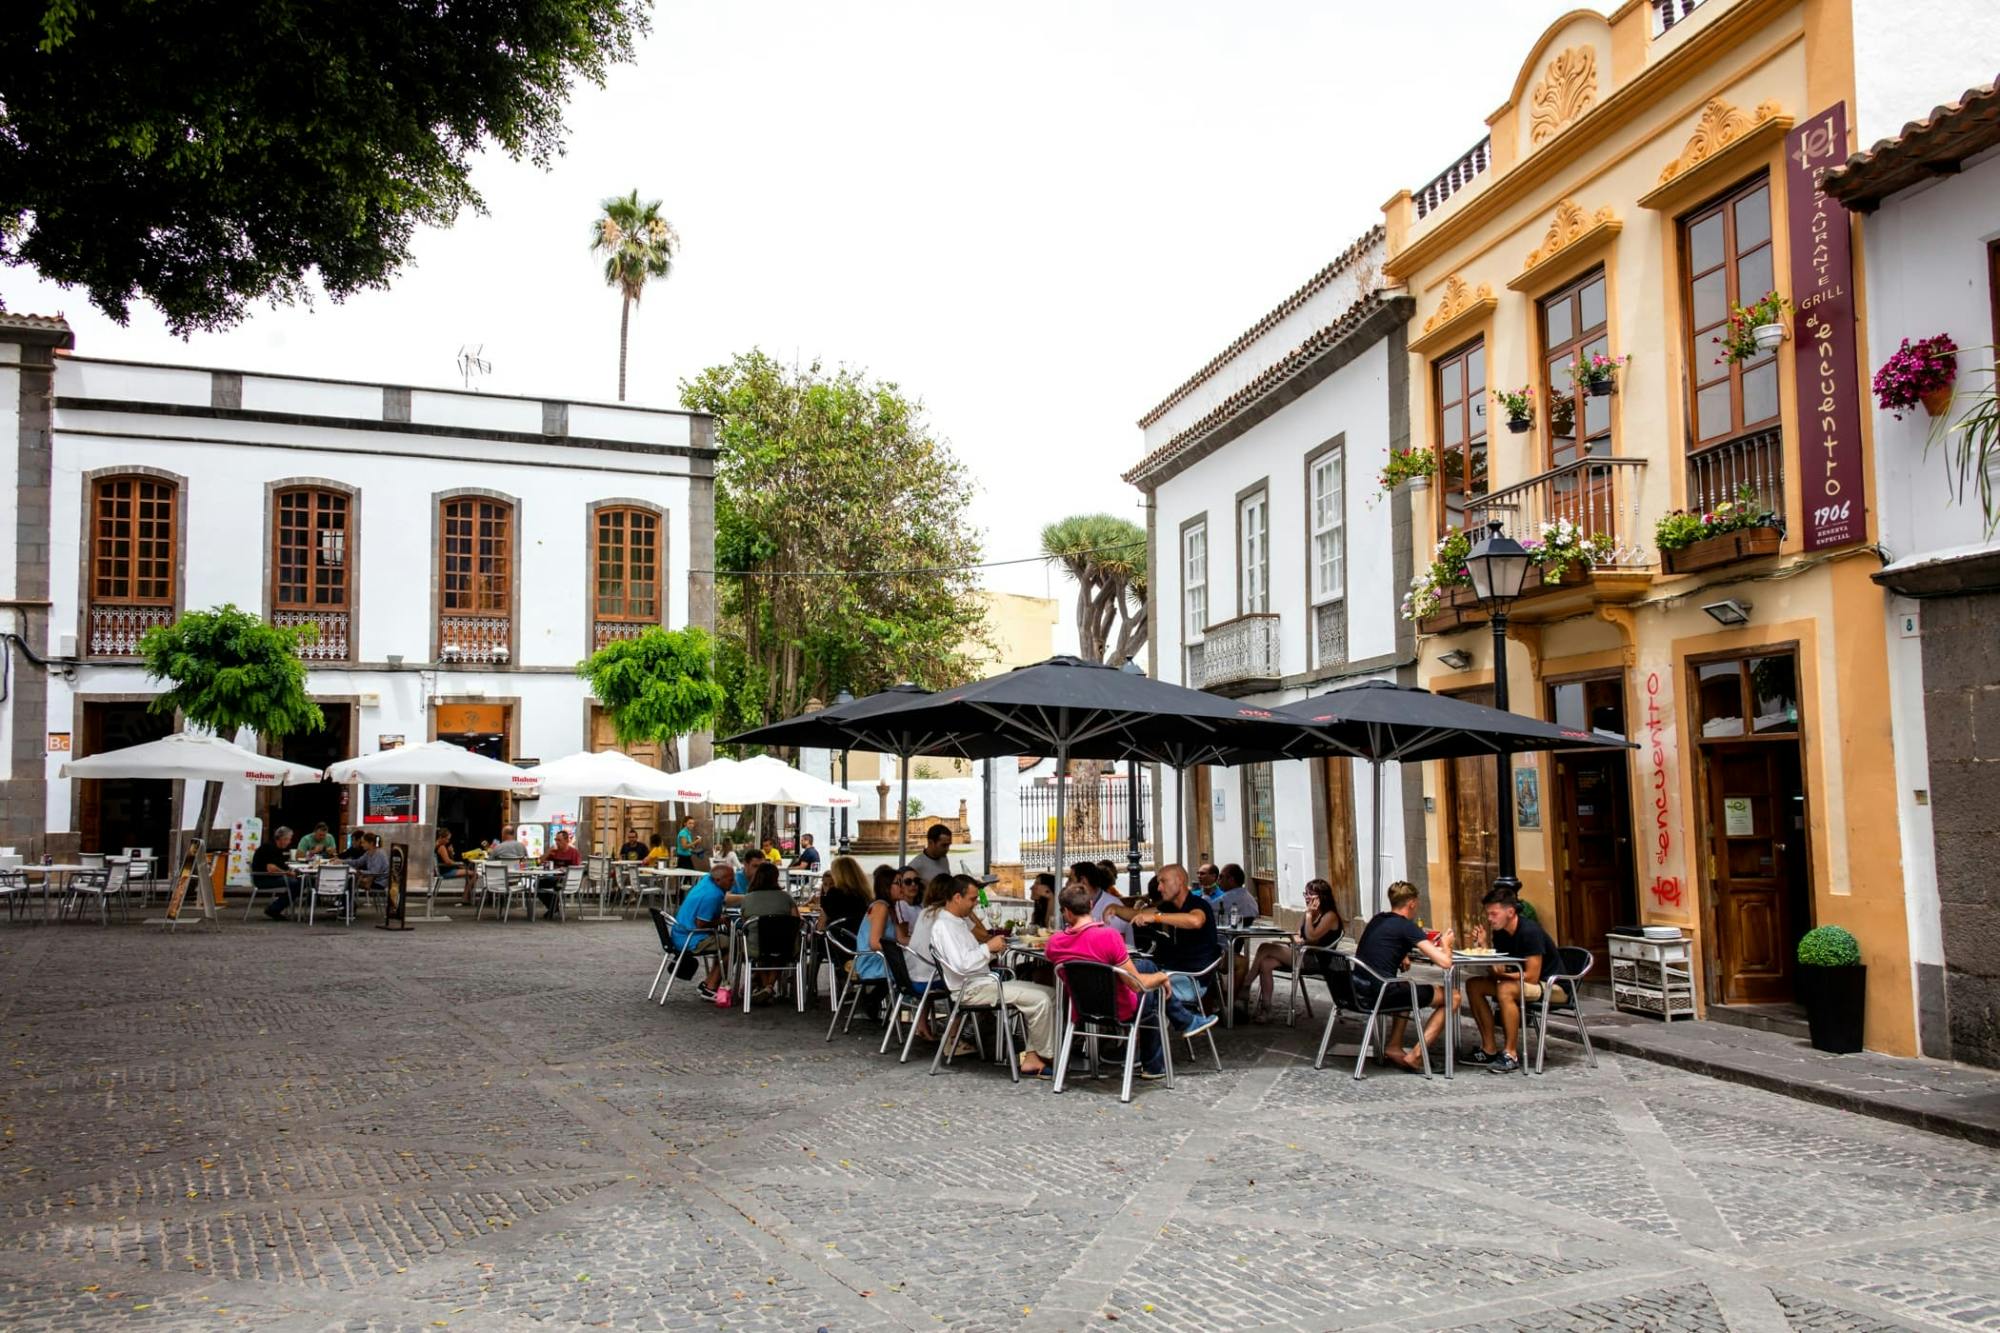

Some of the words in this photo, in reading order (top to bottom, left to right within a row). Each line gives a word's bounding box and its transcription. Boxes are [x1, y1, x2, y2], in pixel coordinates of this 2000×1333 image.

[1801, 285, 1843, 309] GRILL
[1806, 313, 1819, 328] el
[1814, 323, 1841, 496] encuentro
[1814, 500, 1850, 526] 1906
[1817, 525, 1848, 537] RESERVA
[1906, 618, 1913, 631] 8
[50, 736, 70, 750] Bc
[1646, 673, 1670, 857] encuentro
[245, 770, 275, 780] Mahou
